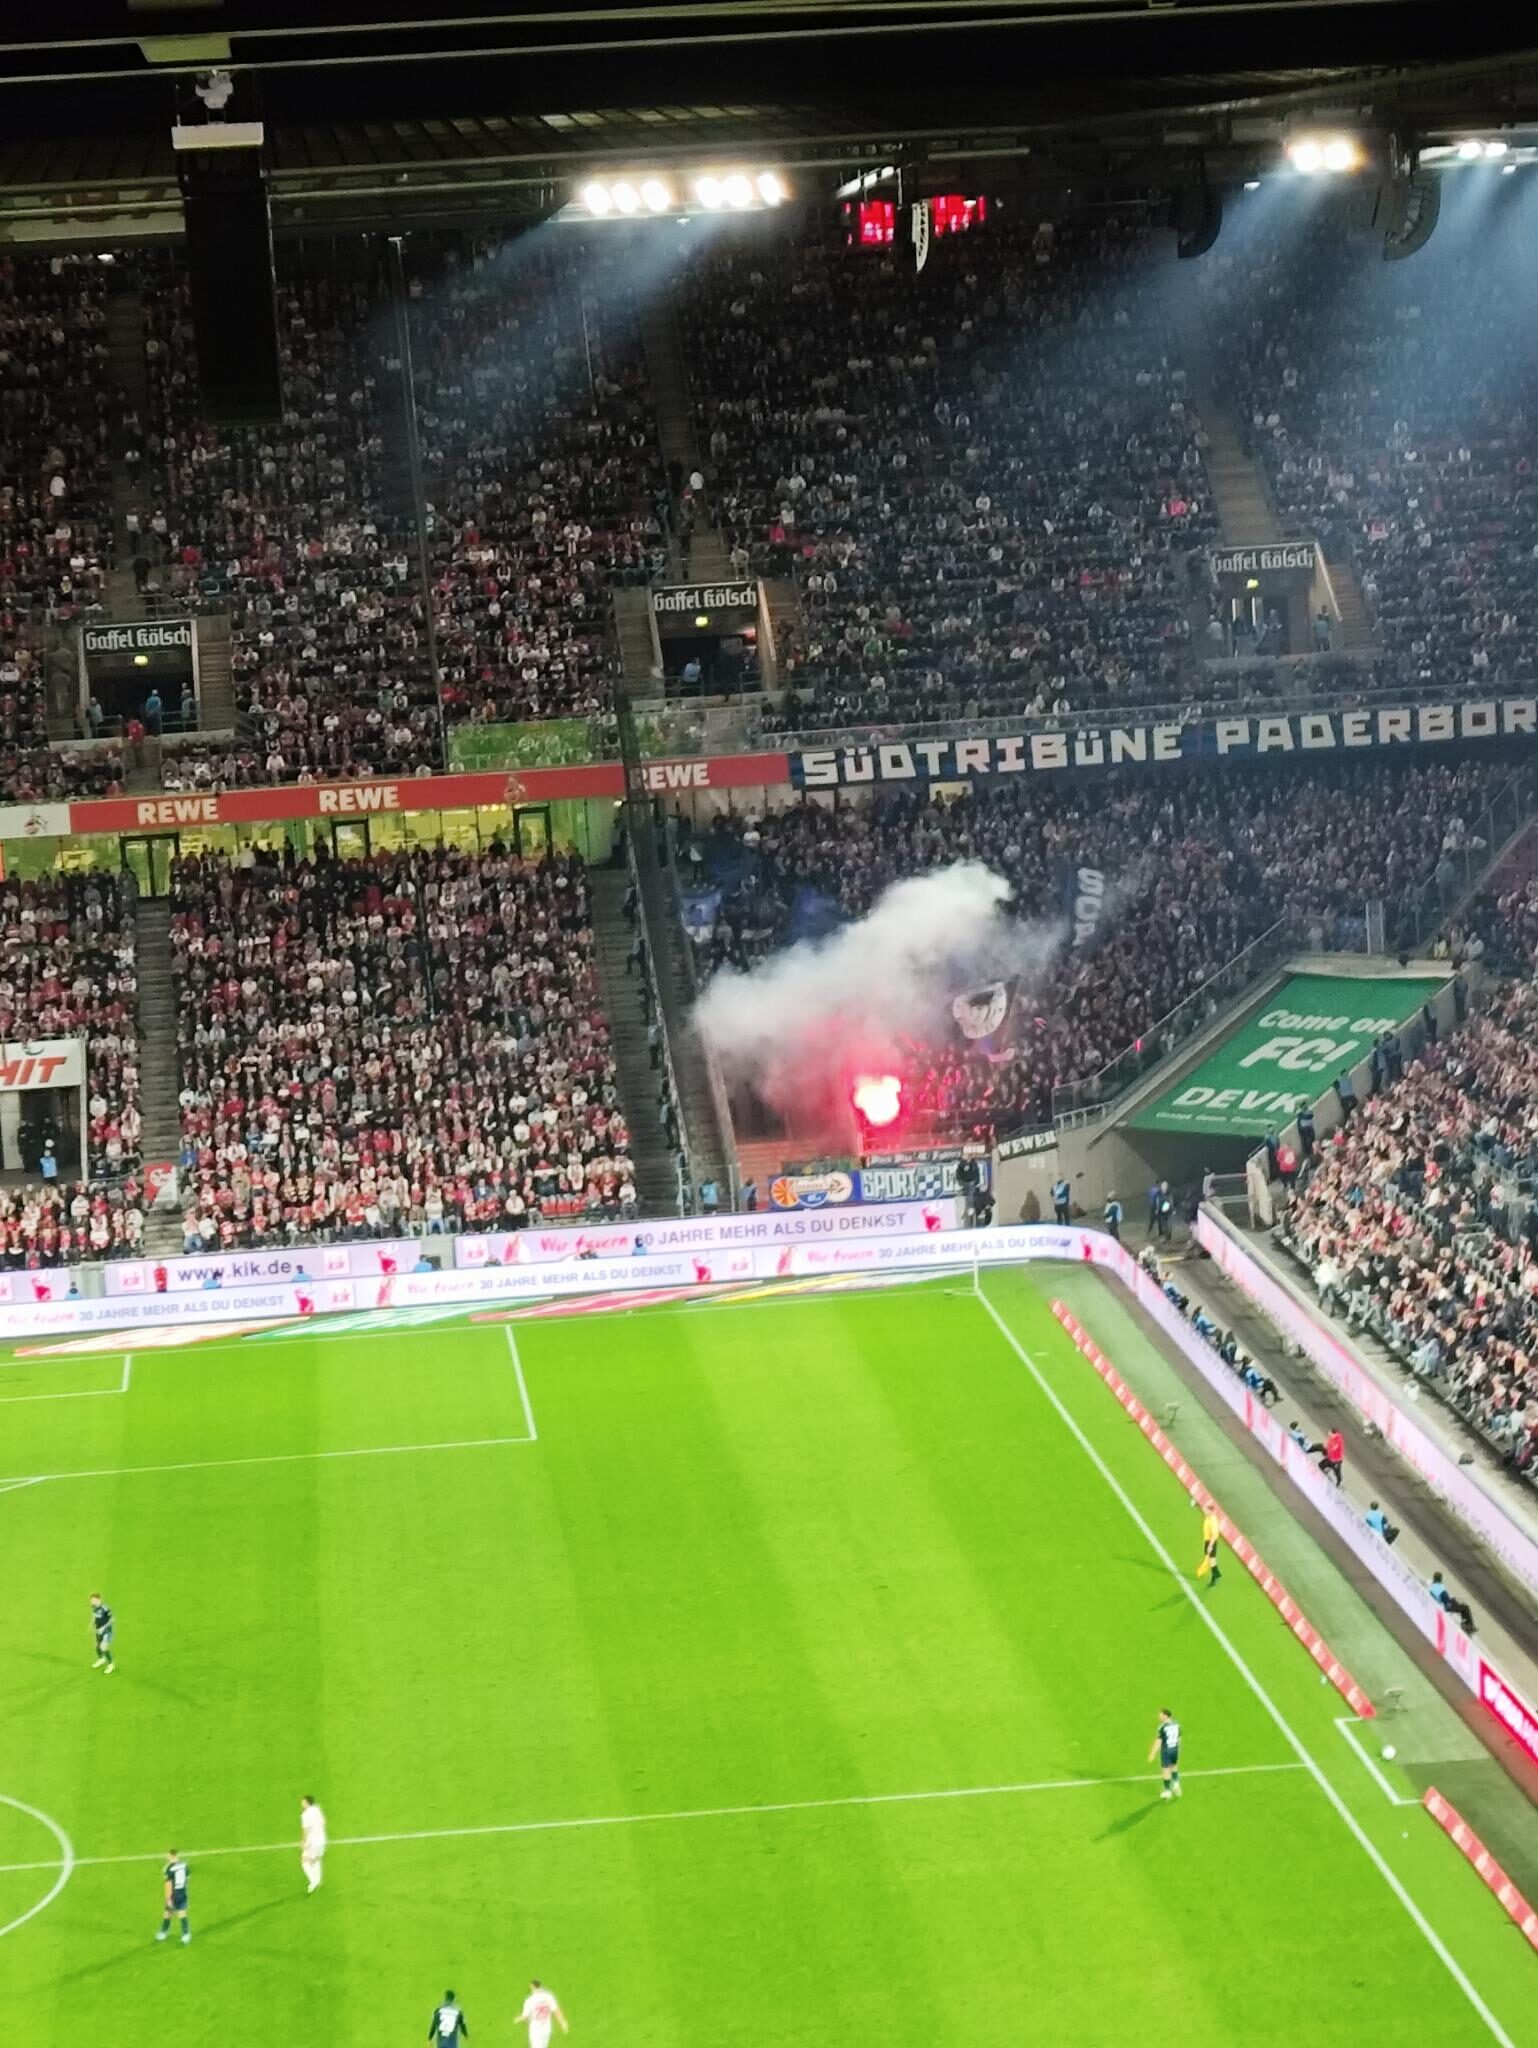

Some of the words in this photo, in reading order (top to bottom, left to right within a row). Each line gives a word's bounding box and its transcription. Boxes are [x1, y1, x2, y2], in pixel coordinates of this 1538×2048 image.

[1210, 552, 1258, 573] Gaffel
[1261, 548, 1316, 570] Kölsch
[654, 590, 702, 611] Gaffel
[704, 586, 757, 609] Kölsch
[86, 629, 134, 650] Gaffel
[136, 626, 191, 647] Kölsch
[801, 725, 1183, 786] SÜDTRIBÜNE
[1215, 699, 1538, 755] PADERBOR
[137, 797, 219, 825] REWE
[318, 786, 400, 812] REWE
[1258, 1009, 1350, 1031] Come
[1350, 1017, 1400, 1034] on
[1238, 1036, 1360, 1072] FC!
[1172, 1086, 1310, 1113] DEVK
[861, 1167, 917, 1199] SPORT
[658, 1227, 714, 1245] JAHRE
[719, 1224, 768, 1240] MEHR
[773, 1220, 805, 1236] ALS
[810, 1218, 835, 1233] DU
[839, 1212, 907, 1231] DENKST
[878, 1248, 892, 1259] 30
[896, 1243, 936, 1257] JAHRE
[980, 1238, 1004, 1250] ALS
[1008, 1237, 1026, 1248] DU
[177, 1260, 292, 1282] www.kik.de
[479, 1278, 493, 1290] 30
[496, 1273, 537, 1288] JAHRE
[542, 1270, 578, 1285] MEHR
[582, 1267, 607, 1282] ALS
[610, 1266, 629, 1280] DU
[633, 1263, 683, 1278] DENKST
[79, 1310, 94, 1322] 30
[96, 1306, 139, 1320] JAHRE
[142, 1303, 180, 1318] MEHR
[183, 1300, 209, 1314] ALS
[211, 1298, 230, 1312] DU
[232, 1295, 285, 1309] DENKST
